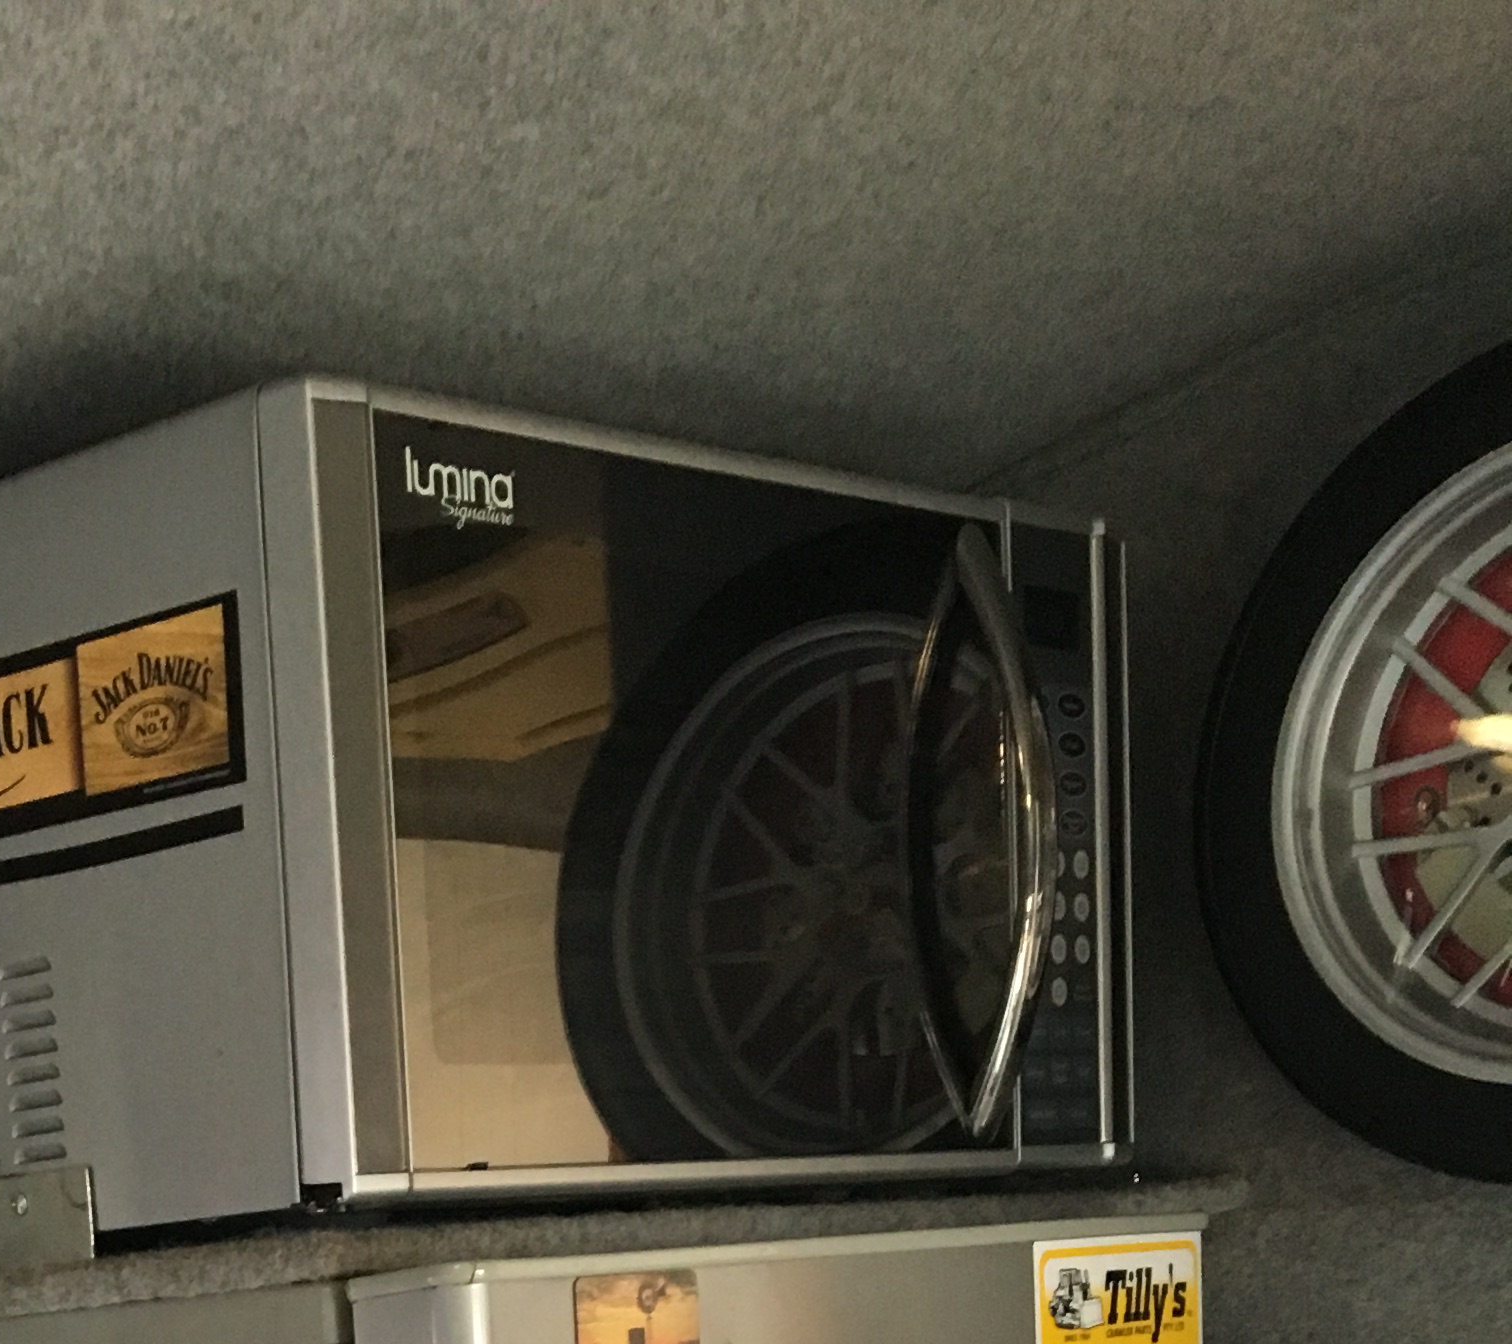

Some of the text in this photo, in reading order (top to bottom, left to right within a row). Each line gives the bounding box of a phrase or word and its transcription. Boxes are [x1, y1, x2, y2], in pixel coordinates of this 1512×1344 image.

[405, 445, 515, 509] lumina
[441, 494, 515, 530] Signature
[92, 667, 138, 724] JACK
[1104, 1262, 1187, 1343] Tilly's
